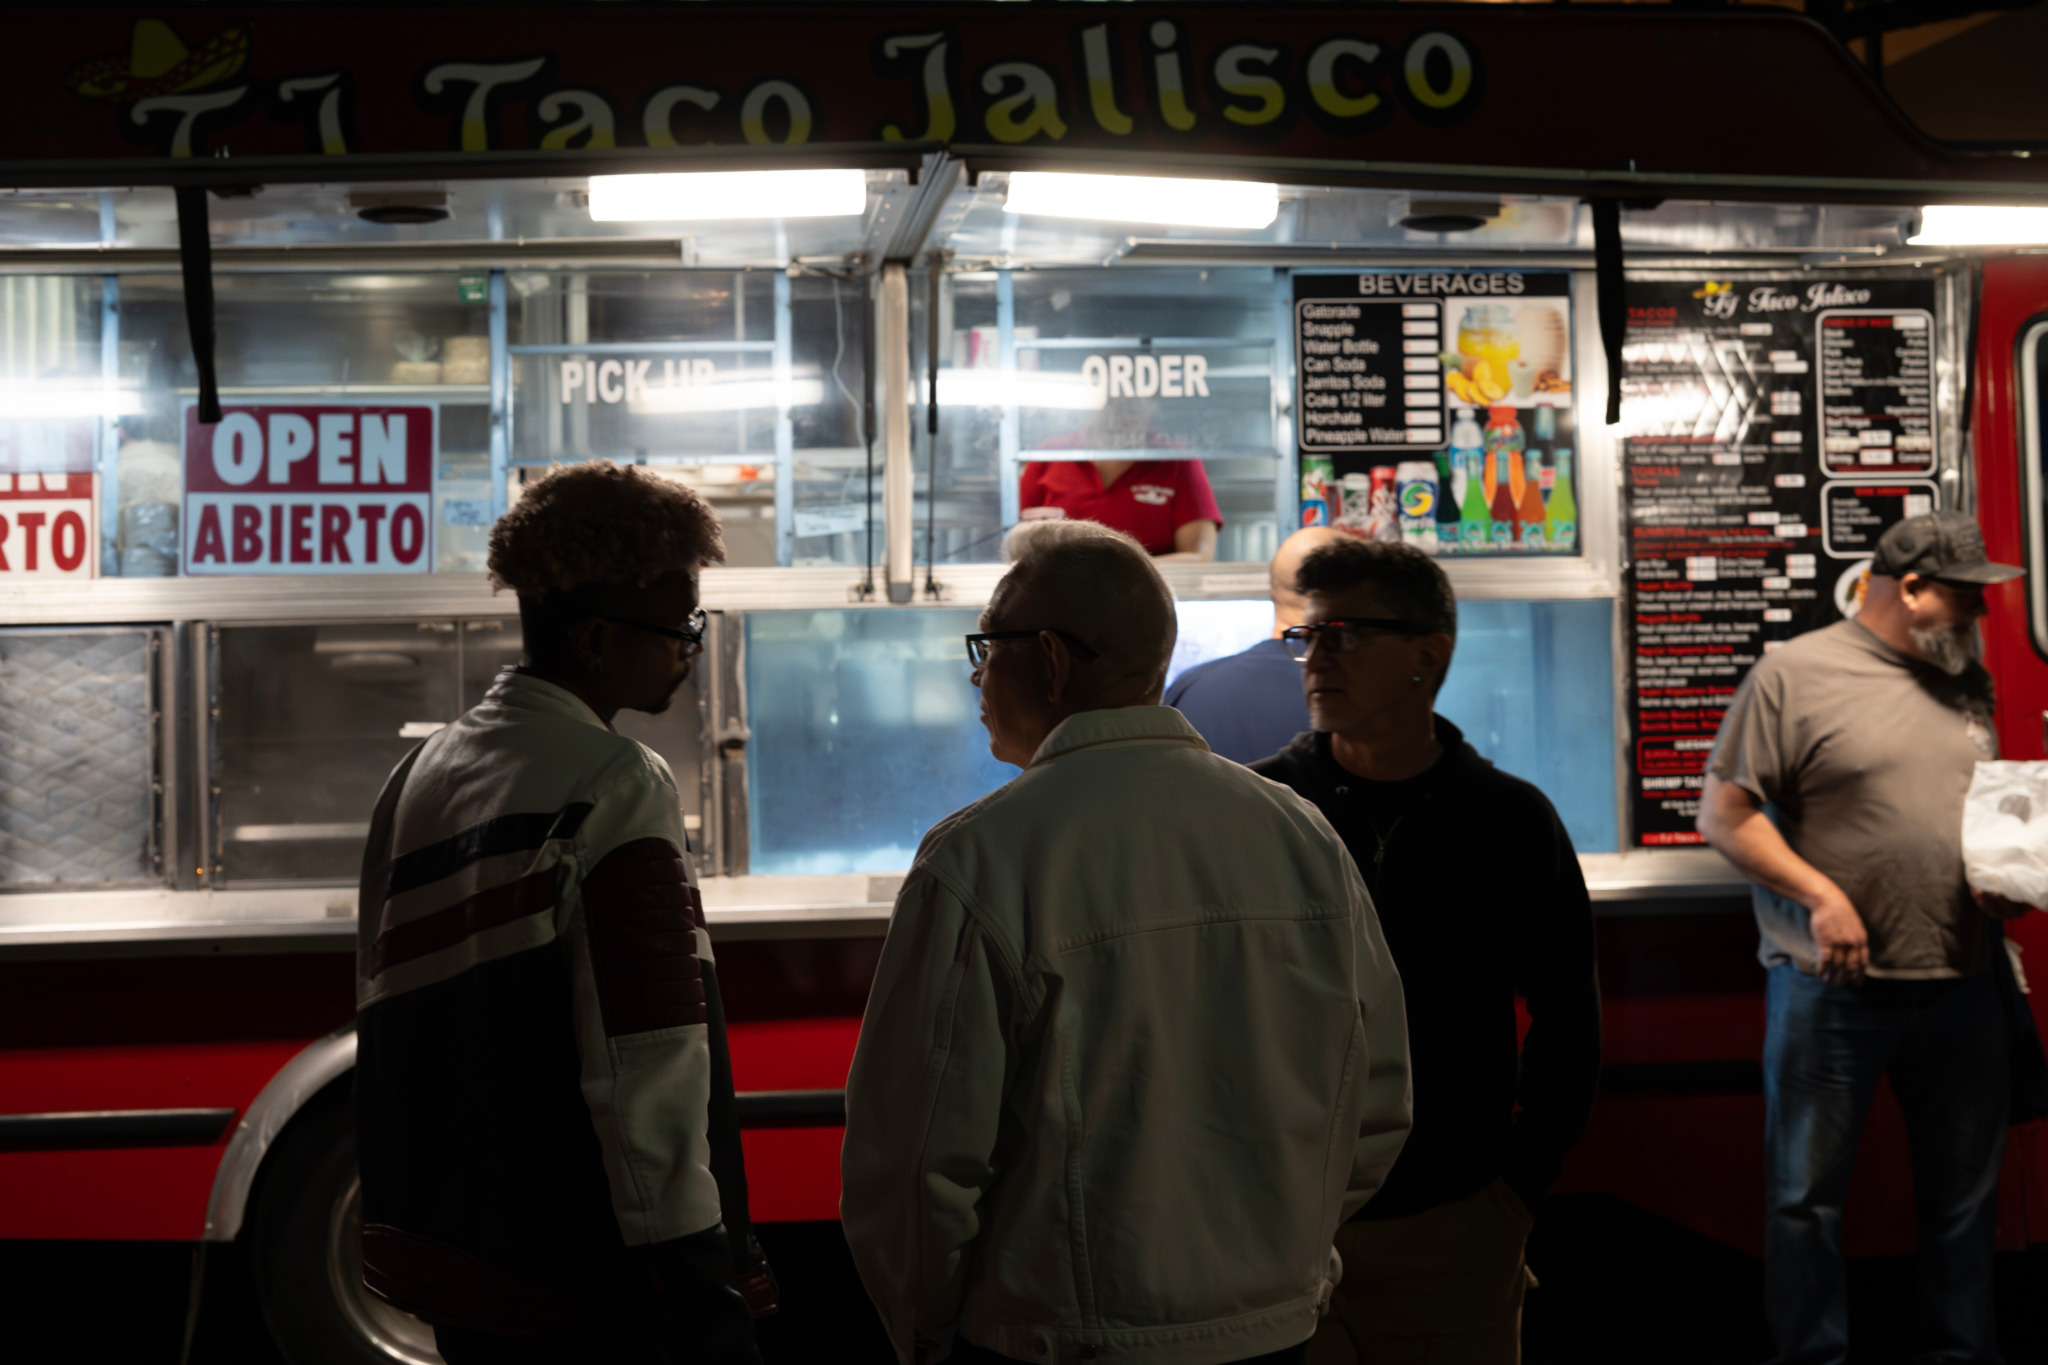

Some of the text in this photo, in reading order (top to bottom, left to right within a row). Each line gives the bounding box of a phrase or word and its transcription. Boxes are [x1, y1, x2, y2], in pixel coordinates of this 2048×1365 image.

[425, 57, 812, 152] Taco
[882, 20, 1473, 143] Jalisco
[1358, 273, 1525, 294] BEVERAGES
[1302, 303, 1361, 320] Gatorade
[1303, 321, 1355, 338] Snapple
[560, 358, 653, 404] PICK
[1081, 353, 1210, 398] ORDER
[212, 411, 408, 486] OPEN
[191, 502, 425, 565] ABIERTO
